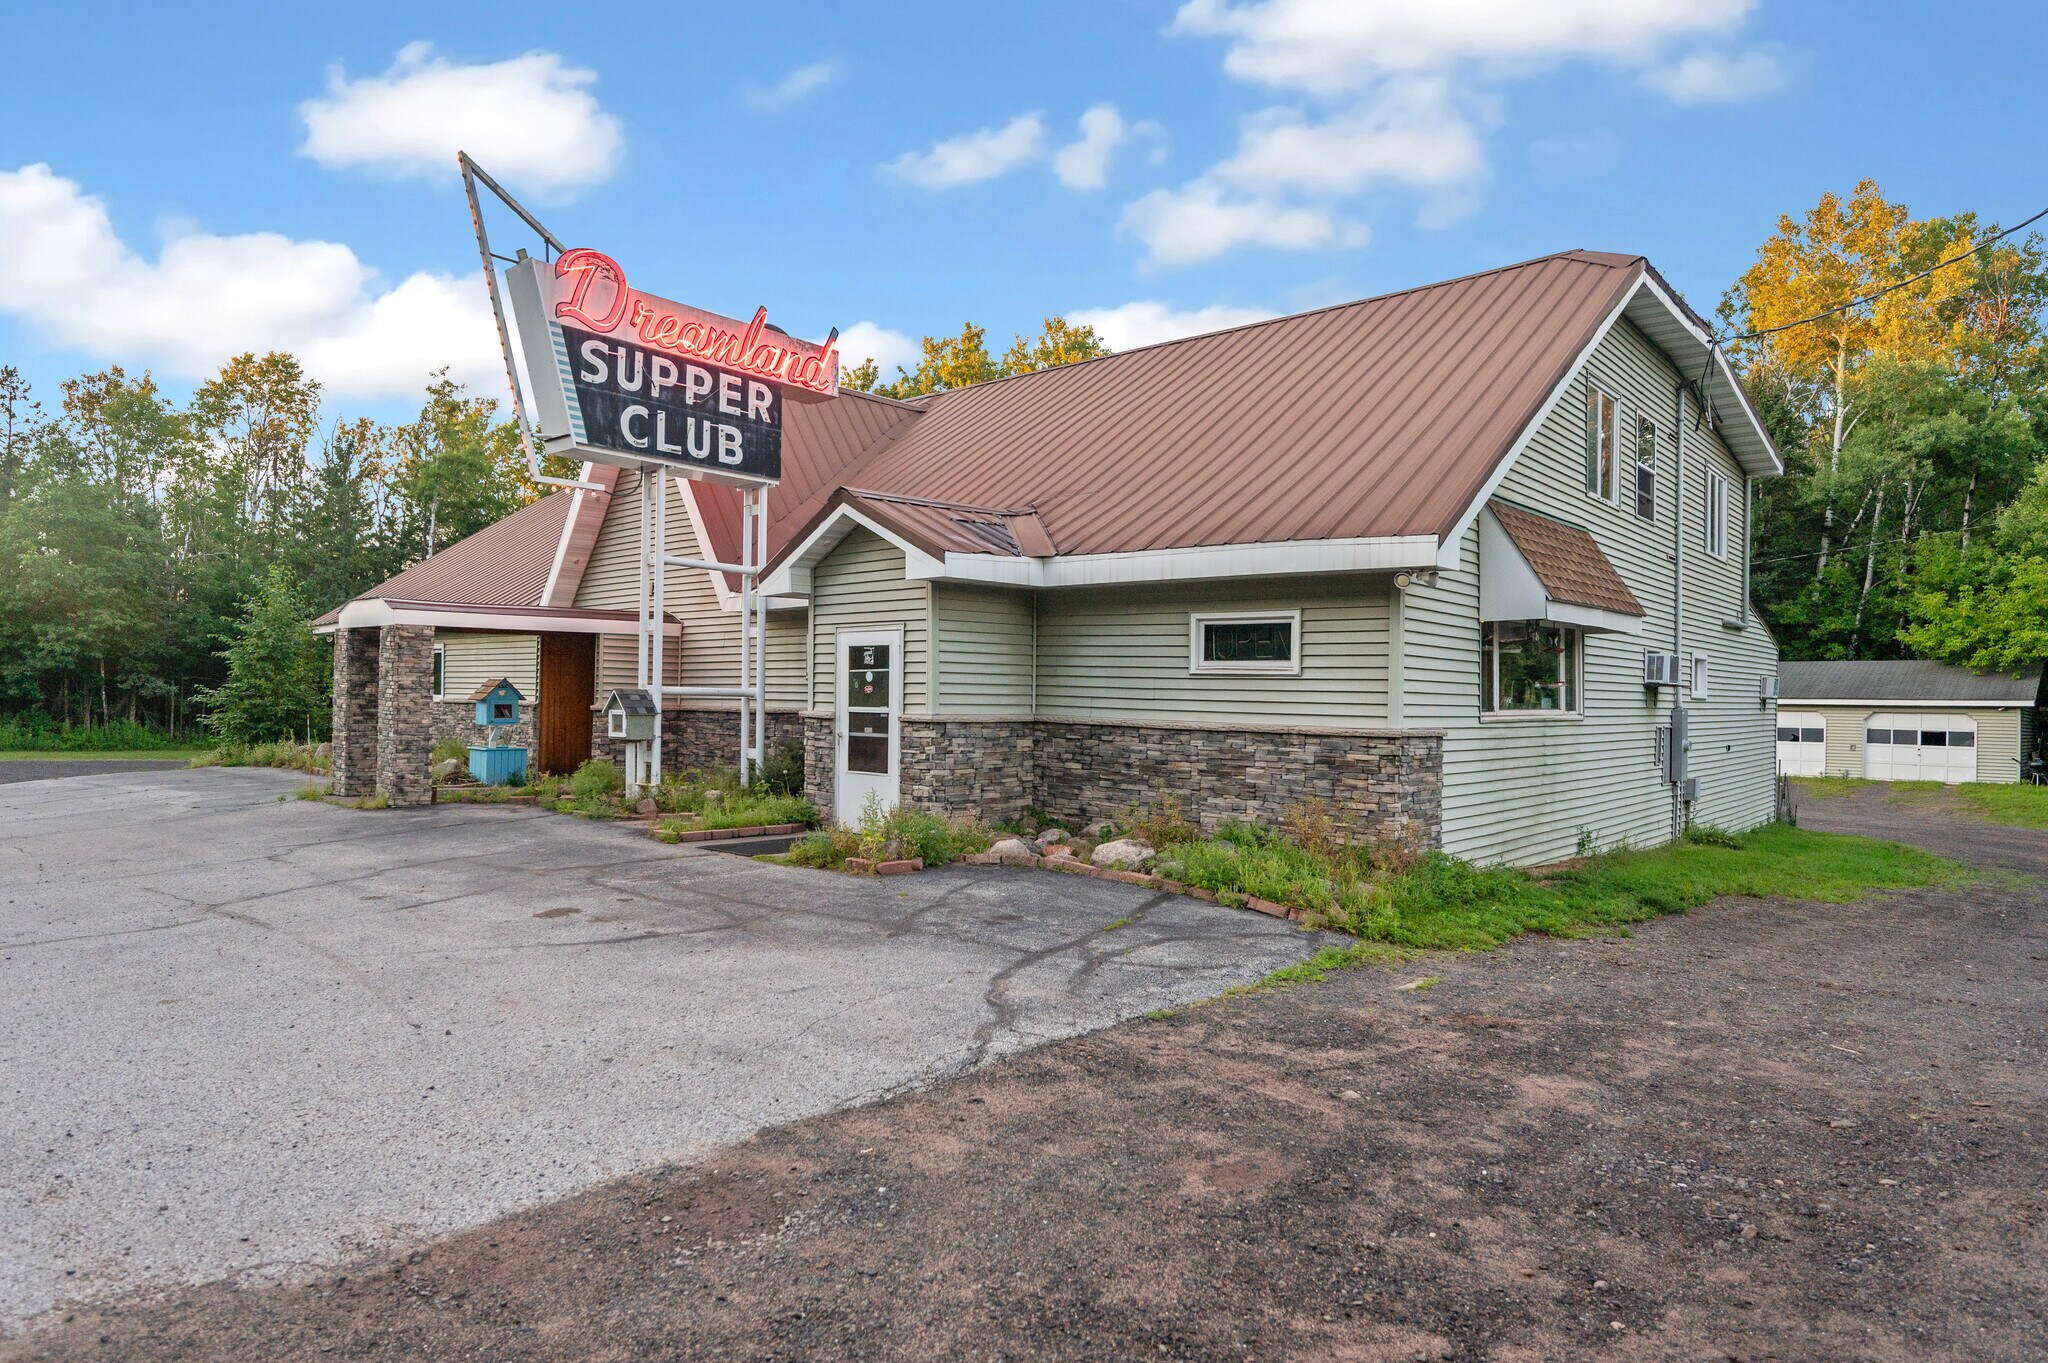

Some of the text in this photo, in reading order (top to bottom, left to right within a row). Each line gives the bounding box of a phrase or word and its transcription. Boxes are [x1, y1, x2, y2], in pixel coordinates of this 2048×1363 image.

[555, 247, 839, 391] Dreamland
[580, 340, 773, 423] SUPPER
[620, 404, 744, 466] CLUB
[1216, 626, 1291, 659] OPEN
